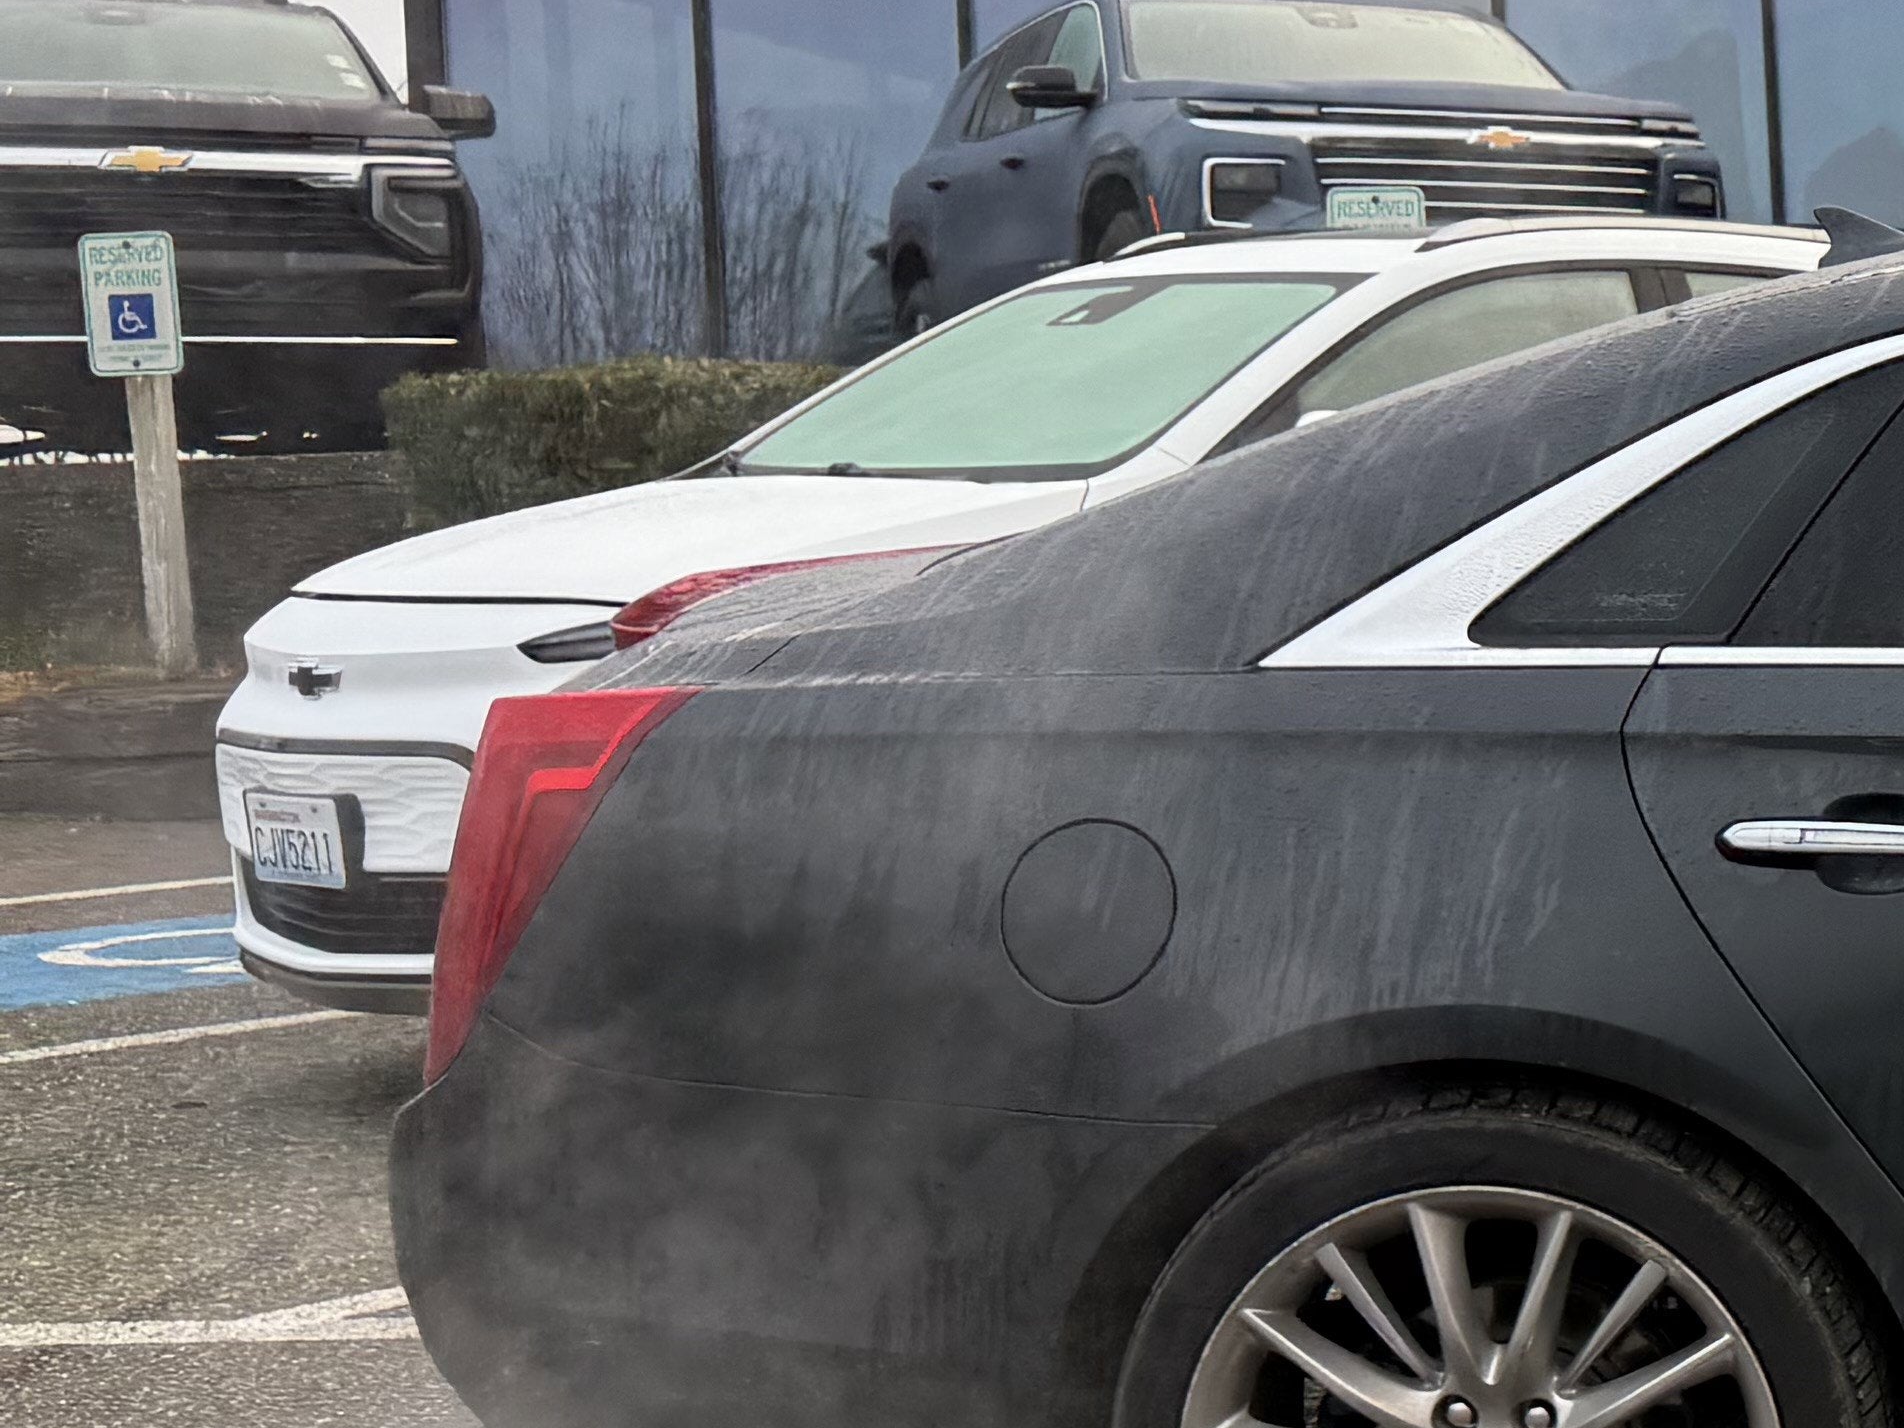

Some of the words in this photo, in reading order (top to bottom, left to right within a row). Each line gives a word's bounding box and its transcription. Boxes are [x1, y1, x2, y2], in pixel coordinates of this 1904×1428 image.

[1337, 200, 1414, 218] RESERVED
[89, 244, 163, 265] RESERVED
[95, 268, 161, 287] PARKING
[255, 826, 333, 873] CJV5211
